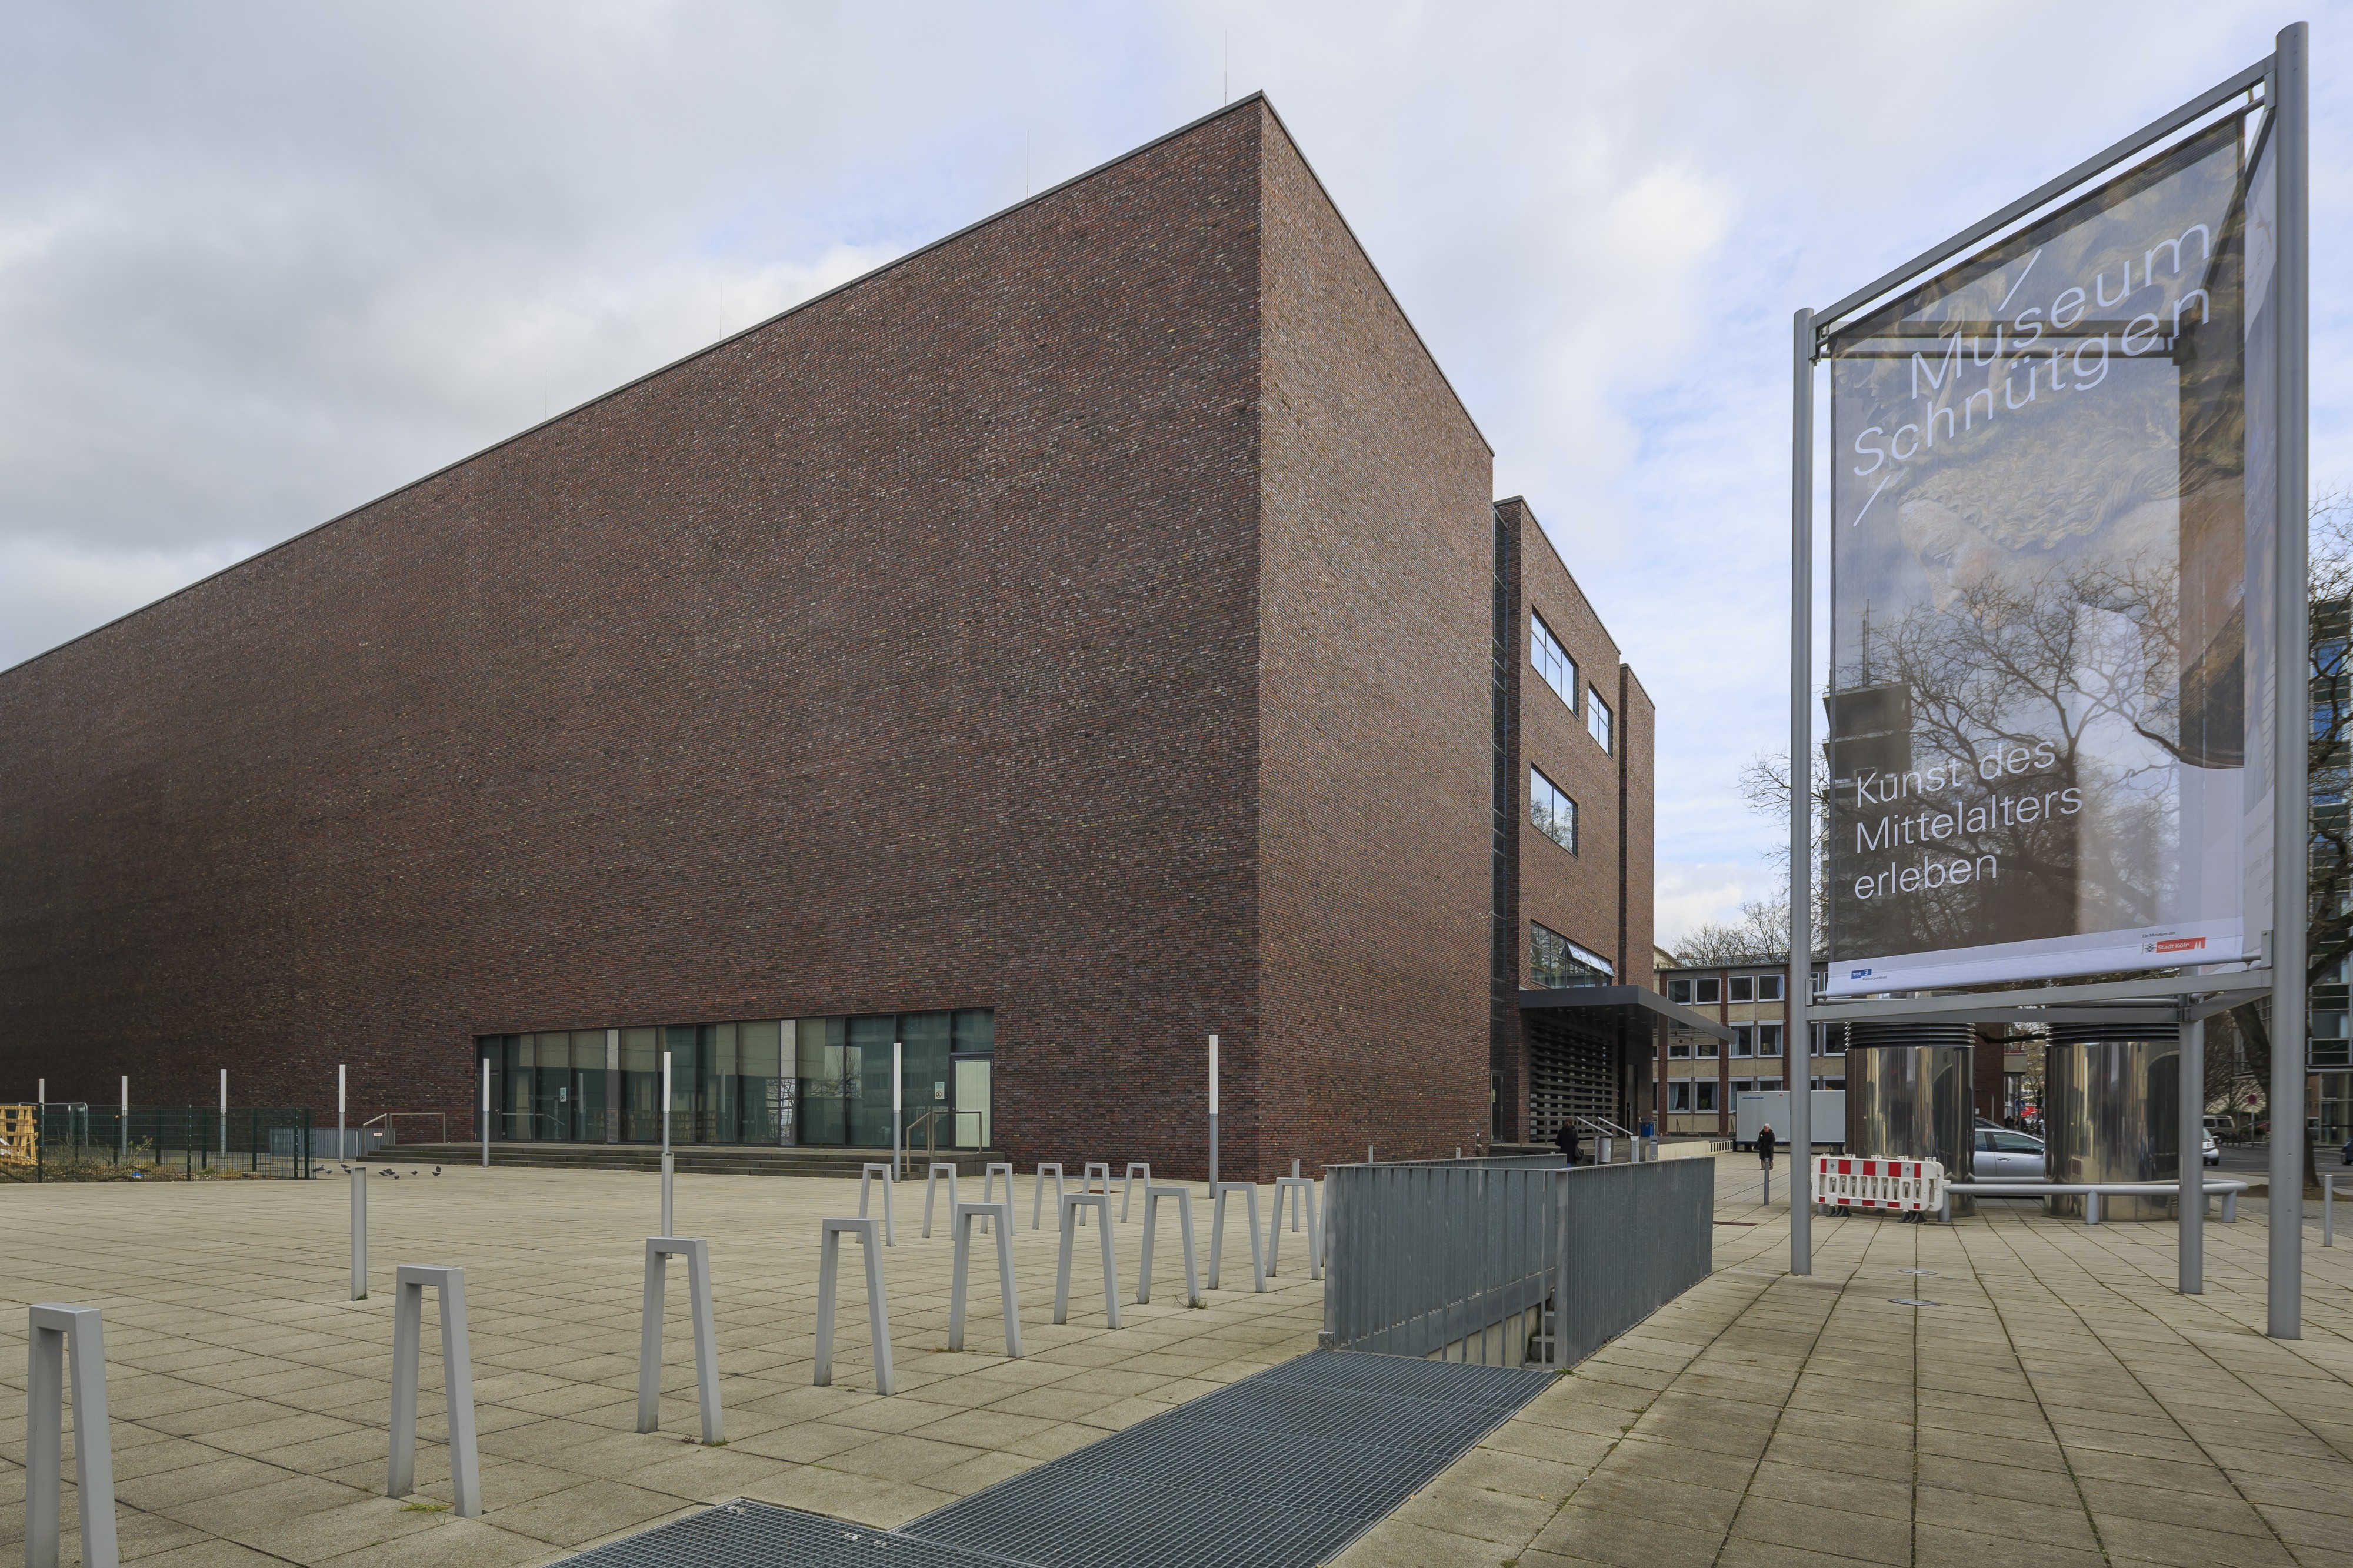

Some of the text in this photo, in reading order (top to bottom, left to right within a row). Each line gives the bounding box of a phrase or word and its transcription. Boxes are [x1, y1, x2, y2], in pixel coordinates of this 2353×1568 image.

[1911, 223, 2211, 400] Museum
[1853, 288, 2210, 477] Schnütgen
[1857, 740, 2056, 809] Kunst des
[1855, 786, 2083, 855] Mittelalters
[1854, 853, 1997, 900] erleben
